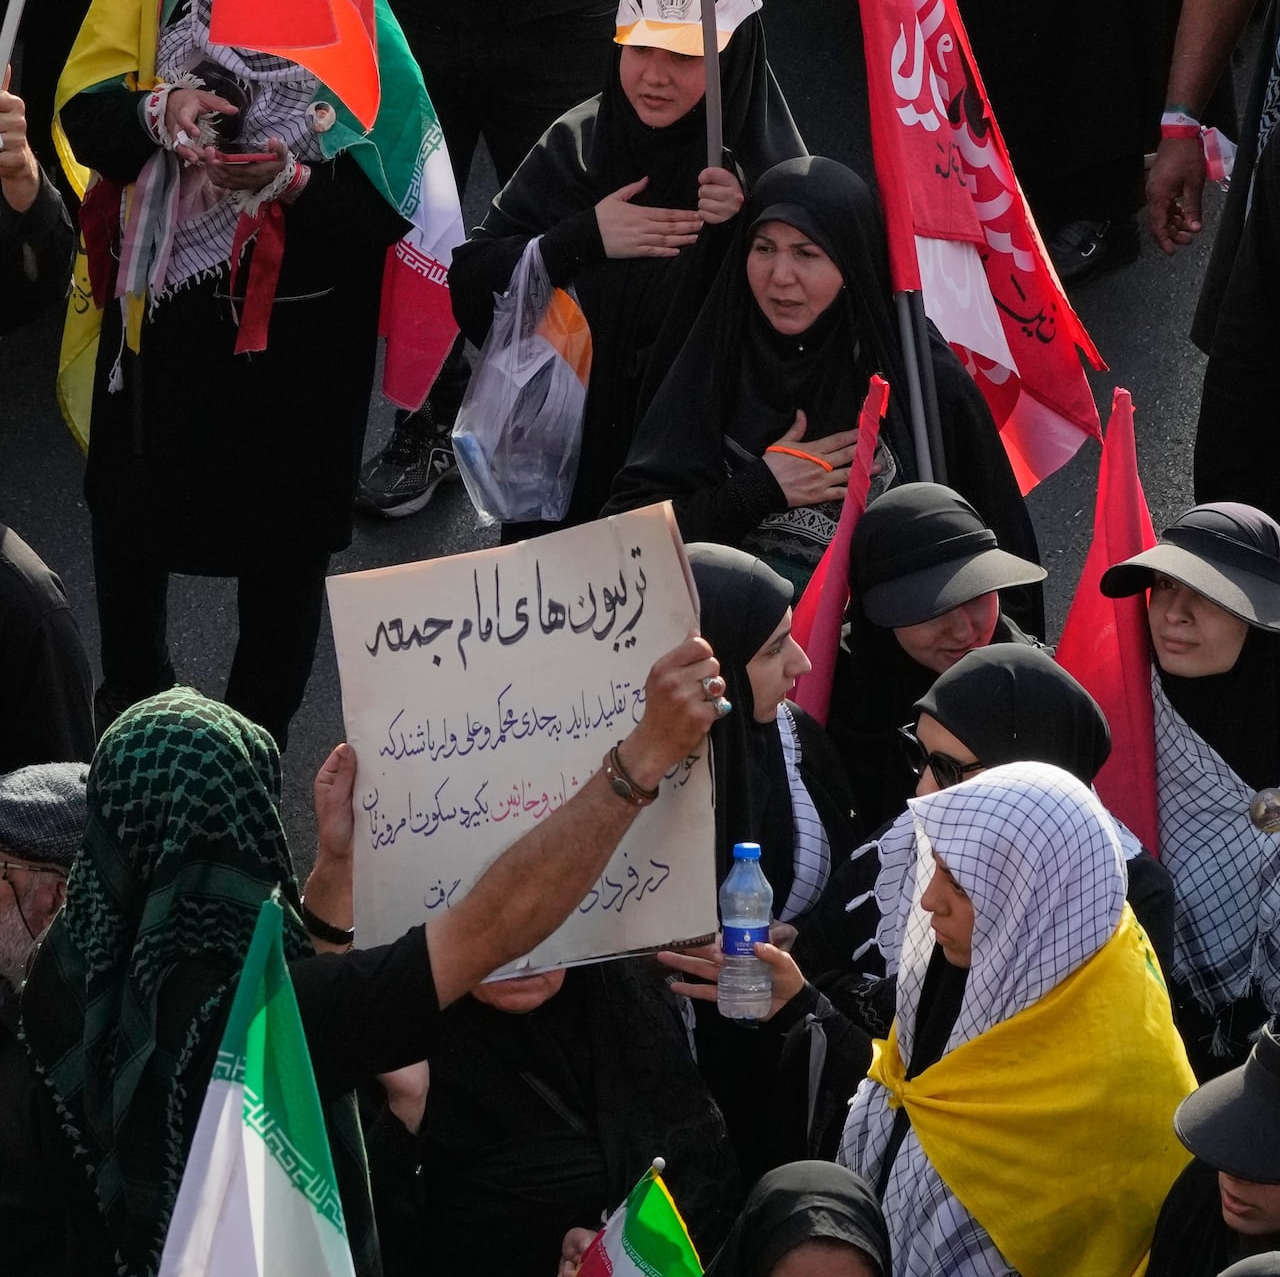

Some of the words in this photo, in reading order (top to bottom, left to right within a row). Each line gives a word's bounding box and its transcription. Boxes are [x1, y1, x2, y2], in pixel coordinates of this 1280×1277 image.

[457, 563, 499, 670] امام
[567, 546, 647, 653] تریبون
[365, 617, 453, 667] جمعه
[490, 684, 518, 750] محکم
[566, 688, 592, 741] باید
[592, 680, 630, 729] تقلید
[411, 777, 457, 836] سکوت
